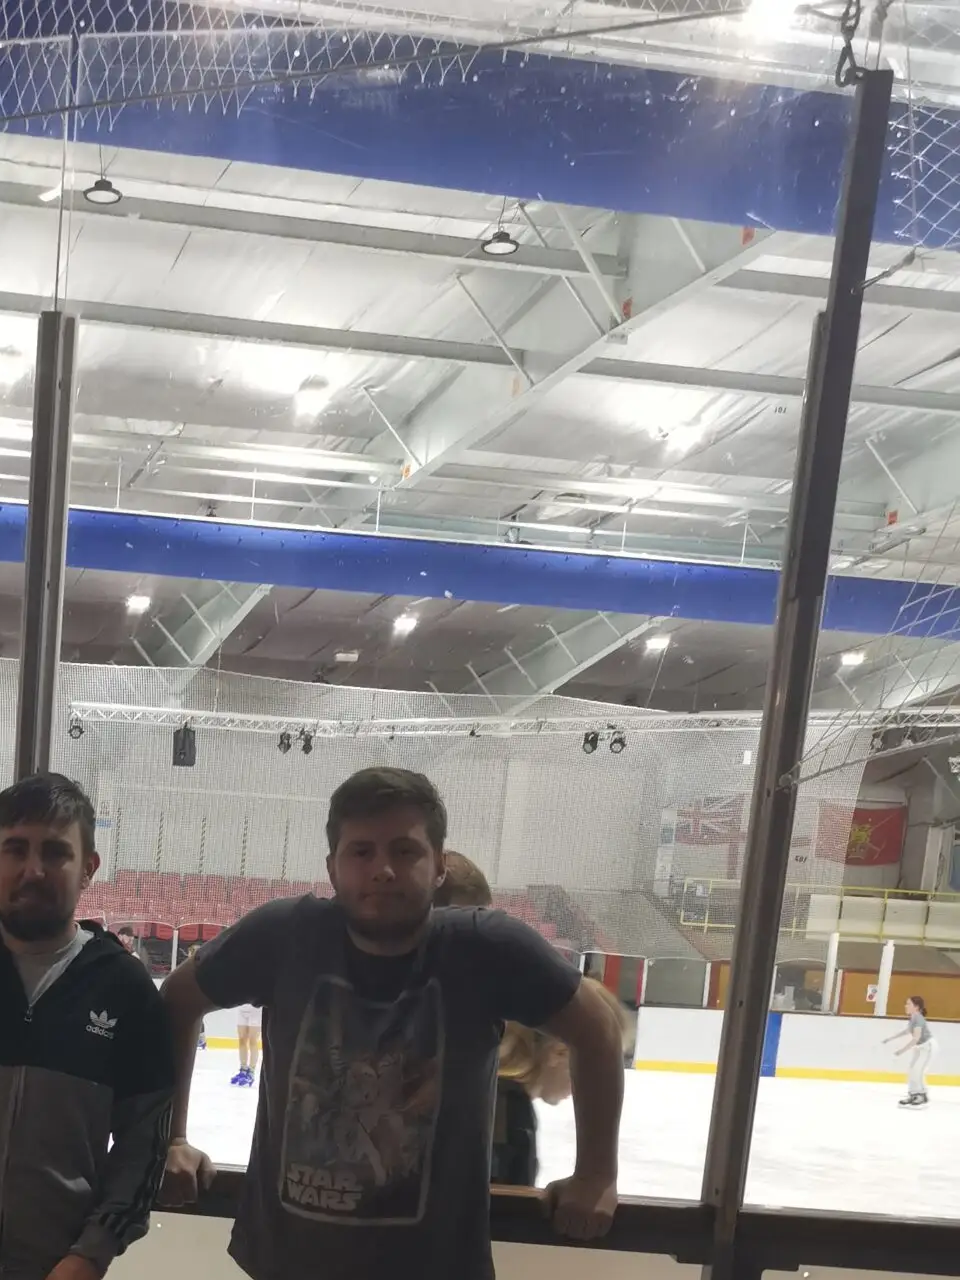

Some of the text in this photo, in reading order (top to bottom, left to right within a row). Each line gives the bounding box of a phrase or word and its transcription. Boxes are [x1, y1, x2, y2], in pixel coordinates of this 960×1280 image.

[85, 1024, 115, 1040] adidas
[286, 1162, 365, 1191] STAR
[286, 1179, 363, 1211] WARS
